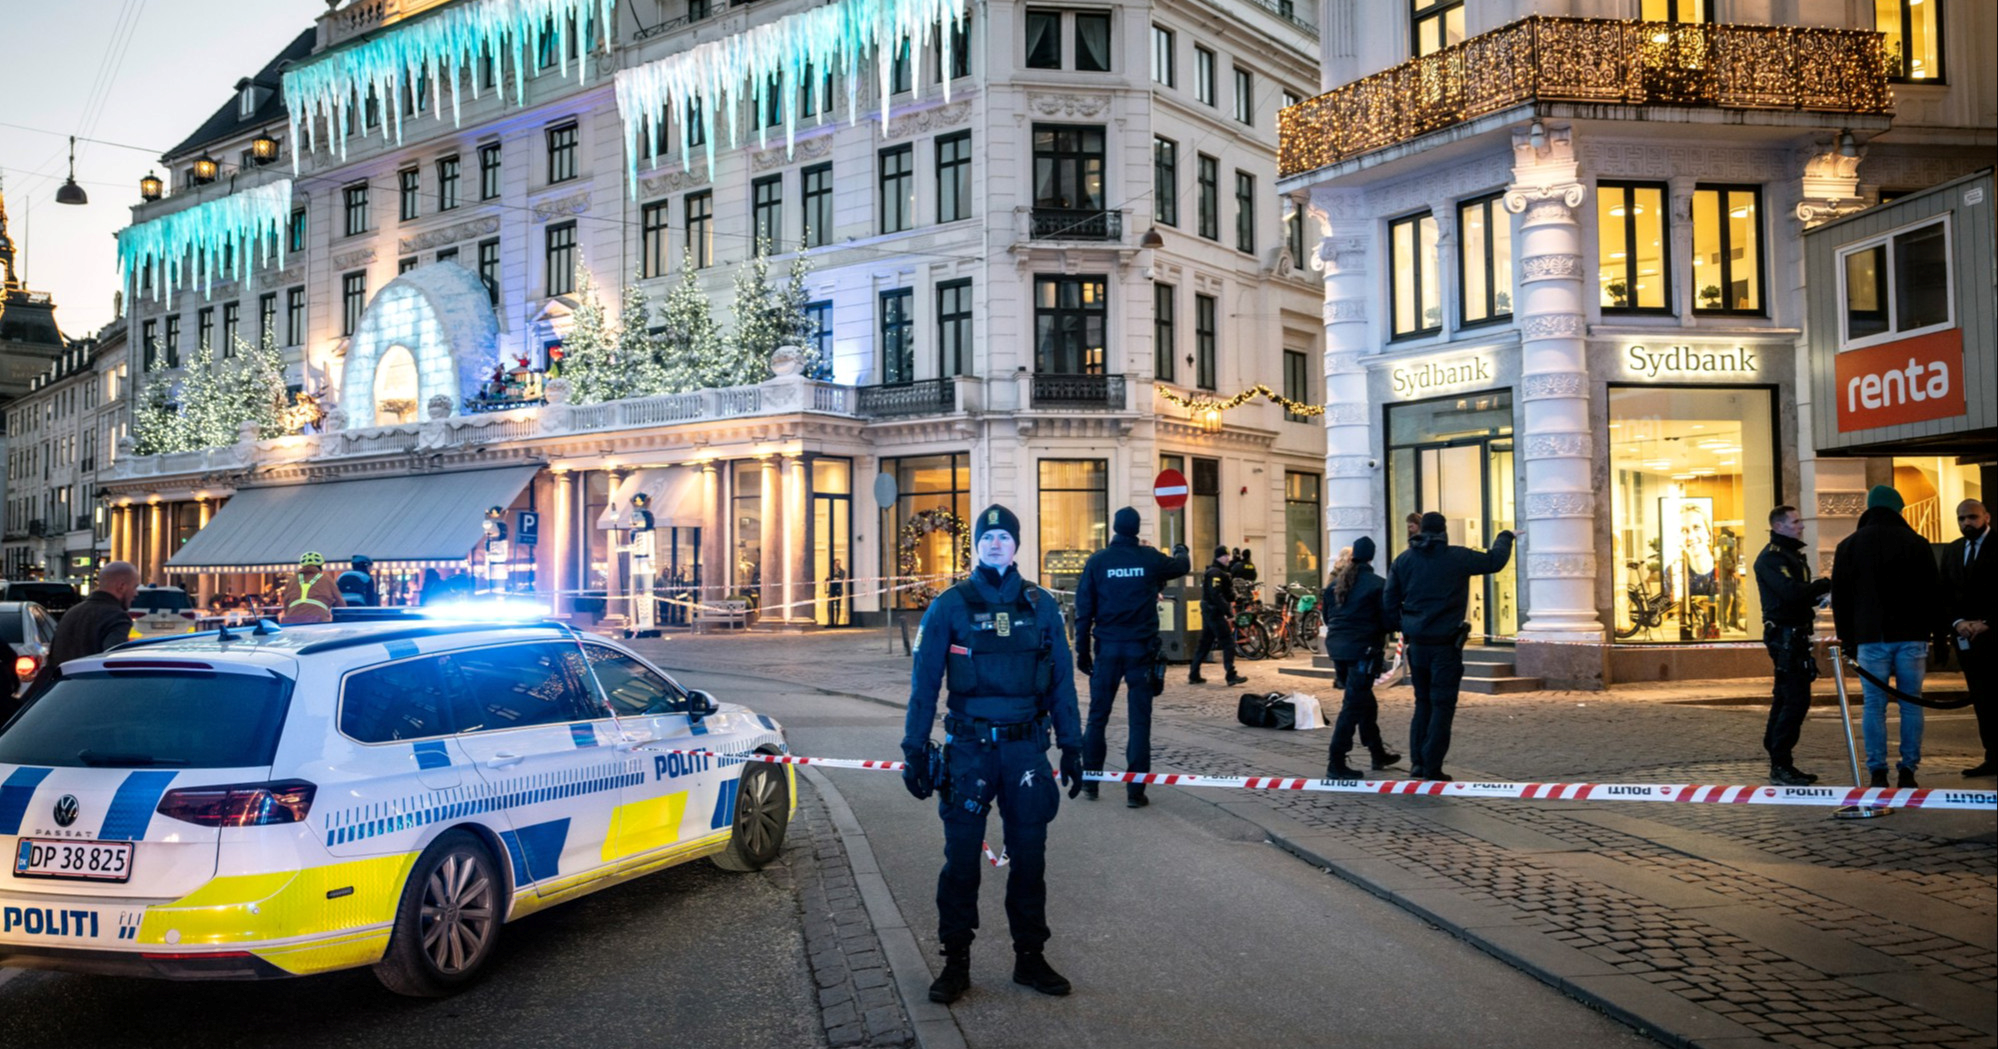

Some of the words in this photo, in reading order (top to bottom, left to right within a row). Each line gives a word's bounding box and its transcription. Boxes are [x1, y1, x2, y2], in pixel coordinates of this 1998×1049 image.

[1629, 345, 1758, 378] Sydbank
[1392, 357, 1490, 397] Sydbank
[1848, 357, 1949, 413] renta
[523, 514, 535, 532] P
[1107, 567, 1144, 578] POLITI
[654, 747, 708, 781] POLITI
[1608, 786, 1651, 795] POLITI
[1785, 788, 1833, 797] POLITI
[1945, 793, 1997, 805] POLITI
[35, 829, 93, 838] PASSAT
[30, 846, 57, 868] DP
[60, 847, 85, 870] 38
[88, 848, 127, 872] 825
[4, 906, 98, 938] POLITI
